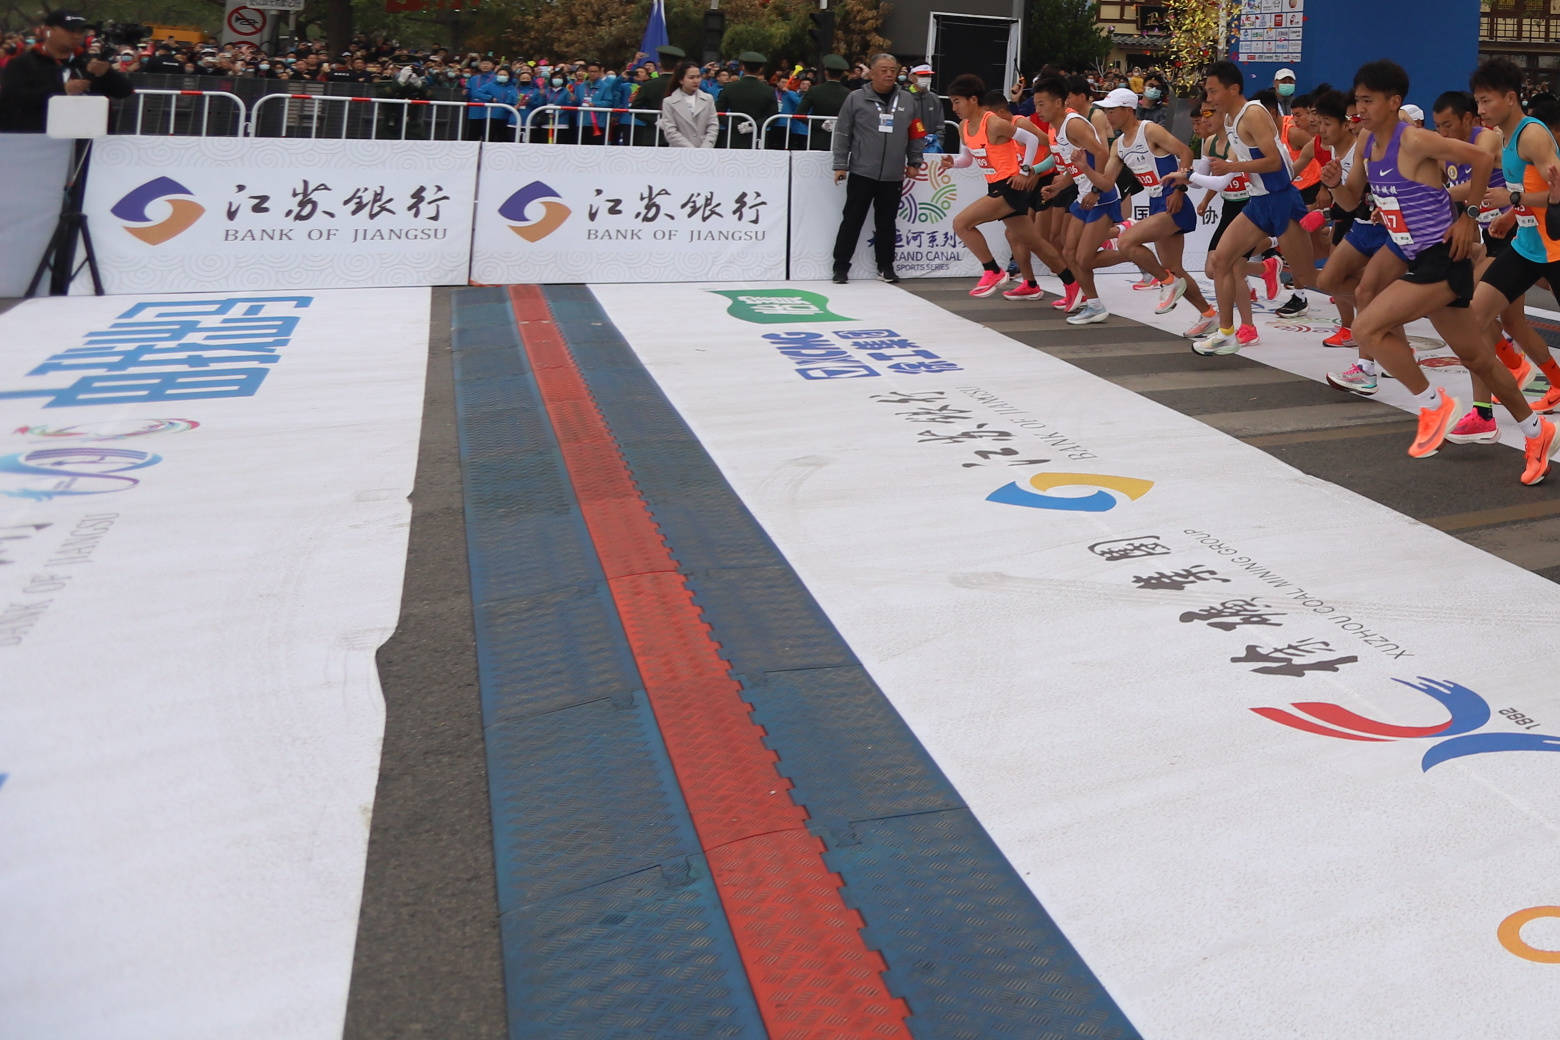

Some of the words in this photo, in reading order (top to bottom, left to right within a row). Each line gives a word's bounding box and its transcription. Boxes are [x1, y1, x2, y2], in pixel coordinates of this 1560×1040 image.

[226, 179, 450, 222] 江苏银行
[588, 185, 768, 225] 江苏银行
[223, 227, 294, 242] BANK
[307, 227, 340, 241] OF
[352, 227, 448, 243] JIANGSU
[586, 228, 643, 241] BANK
[652, 228, 679, 241] OF
[688, 229, 767, 243] JIANGSU
[894, 250, 923, 262] RAND
[925, 251, 964, 262] CANAL
[1008, 416, 1047, 430] OF
[1035, 431, 1099, 461] BANK
[1182, 527, 1238, 558] GROUP
[1231, 555, 1293, 589] MINING
[1291, 586, 1336, 615] COAL
[1328, 614, 1415, 661] XUZHOU
[1498, 706, 1542, 731] 1882
